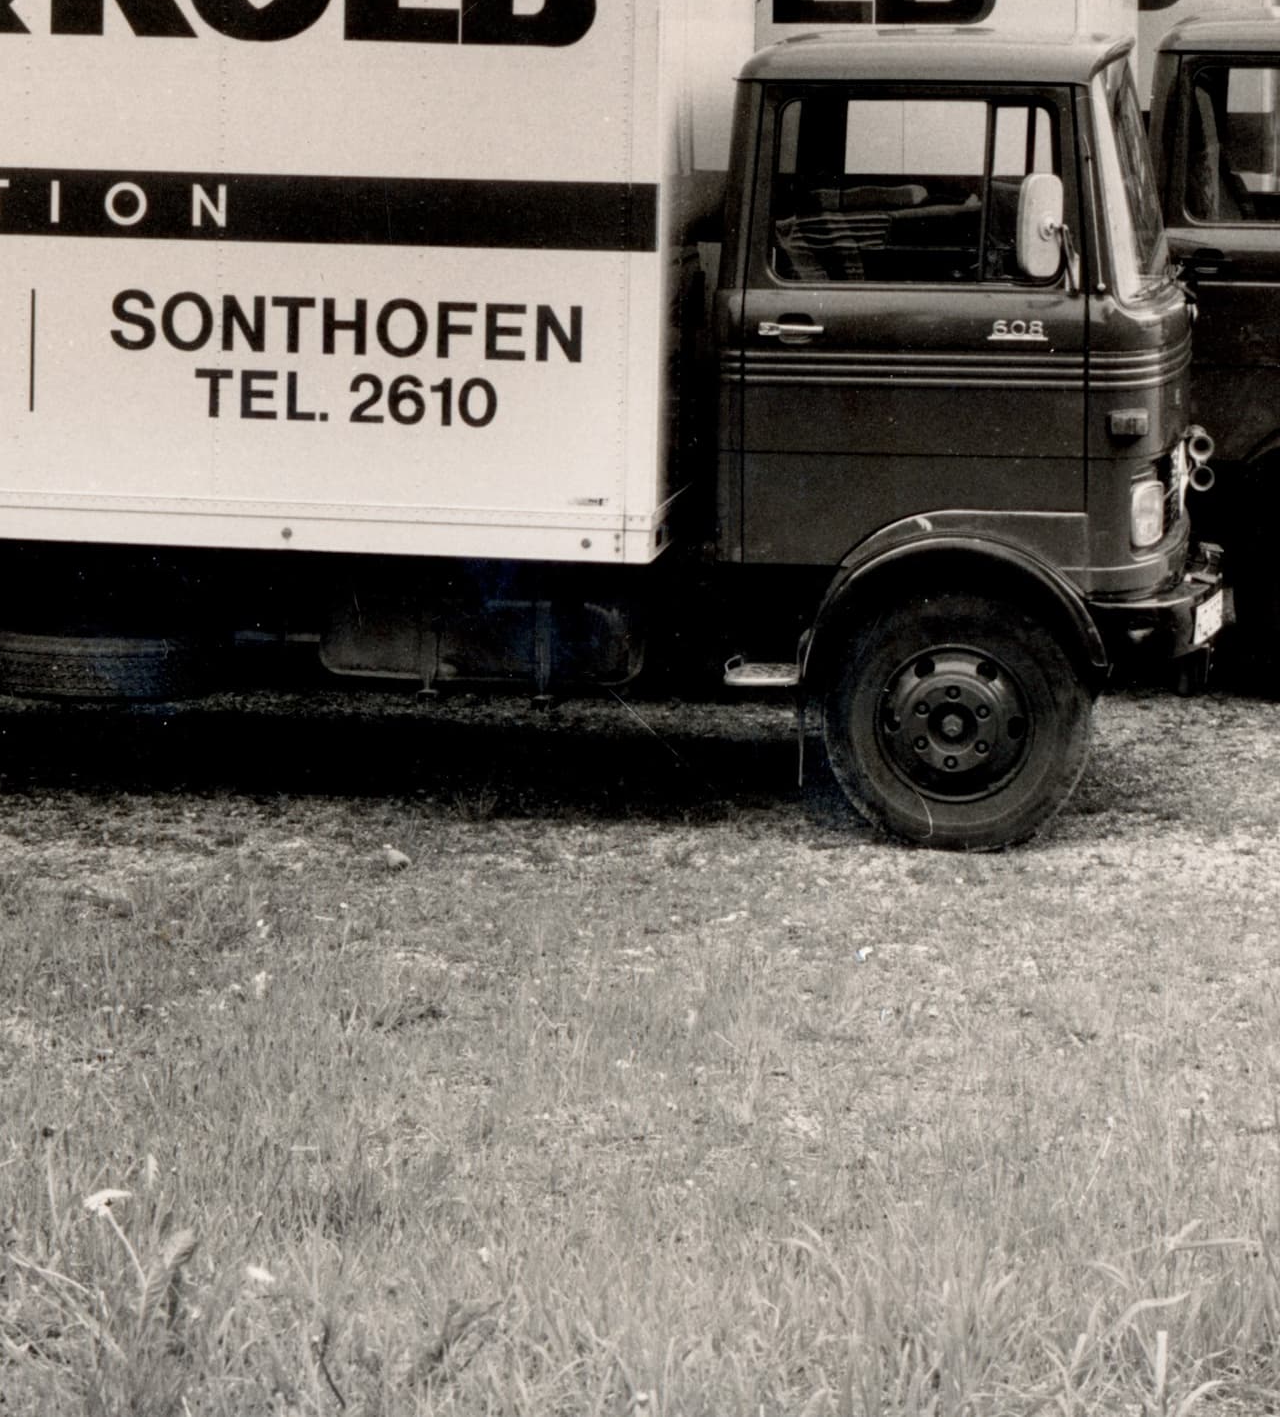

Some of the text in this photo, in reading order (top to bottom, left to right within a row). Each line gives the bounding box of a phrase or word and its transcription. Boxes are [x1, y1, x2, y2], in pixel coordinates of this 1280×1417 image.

[109, 288, 584, 365] SONTHOFEN
[992, 319, 1044, 337] 608
[195, 368, 499, 429] TEL. 2610
